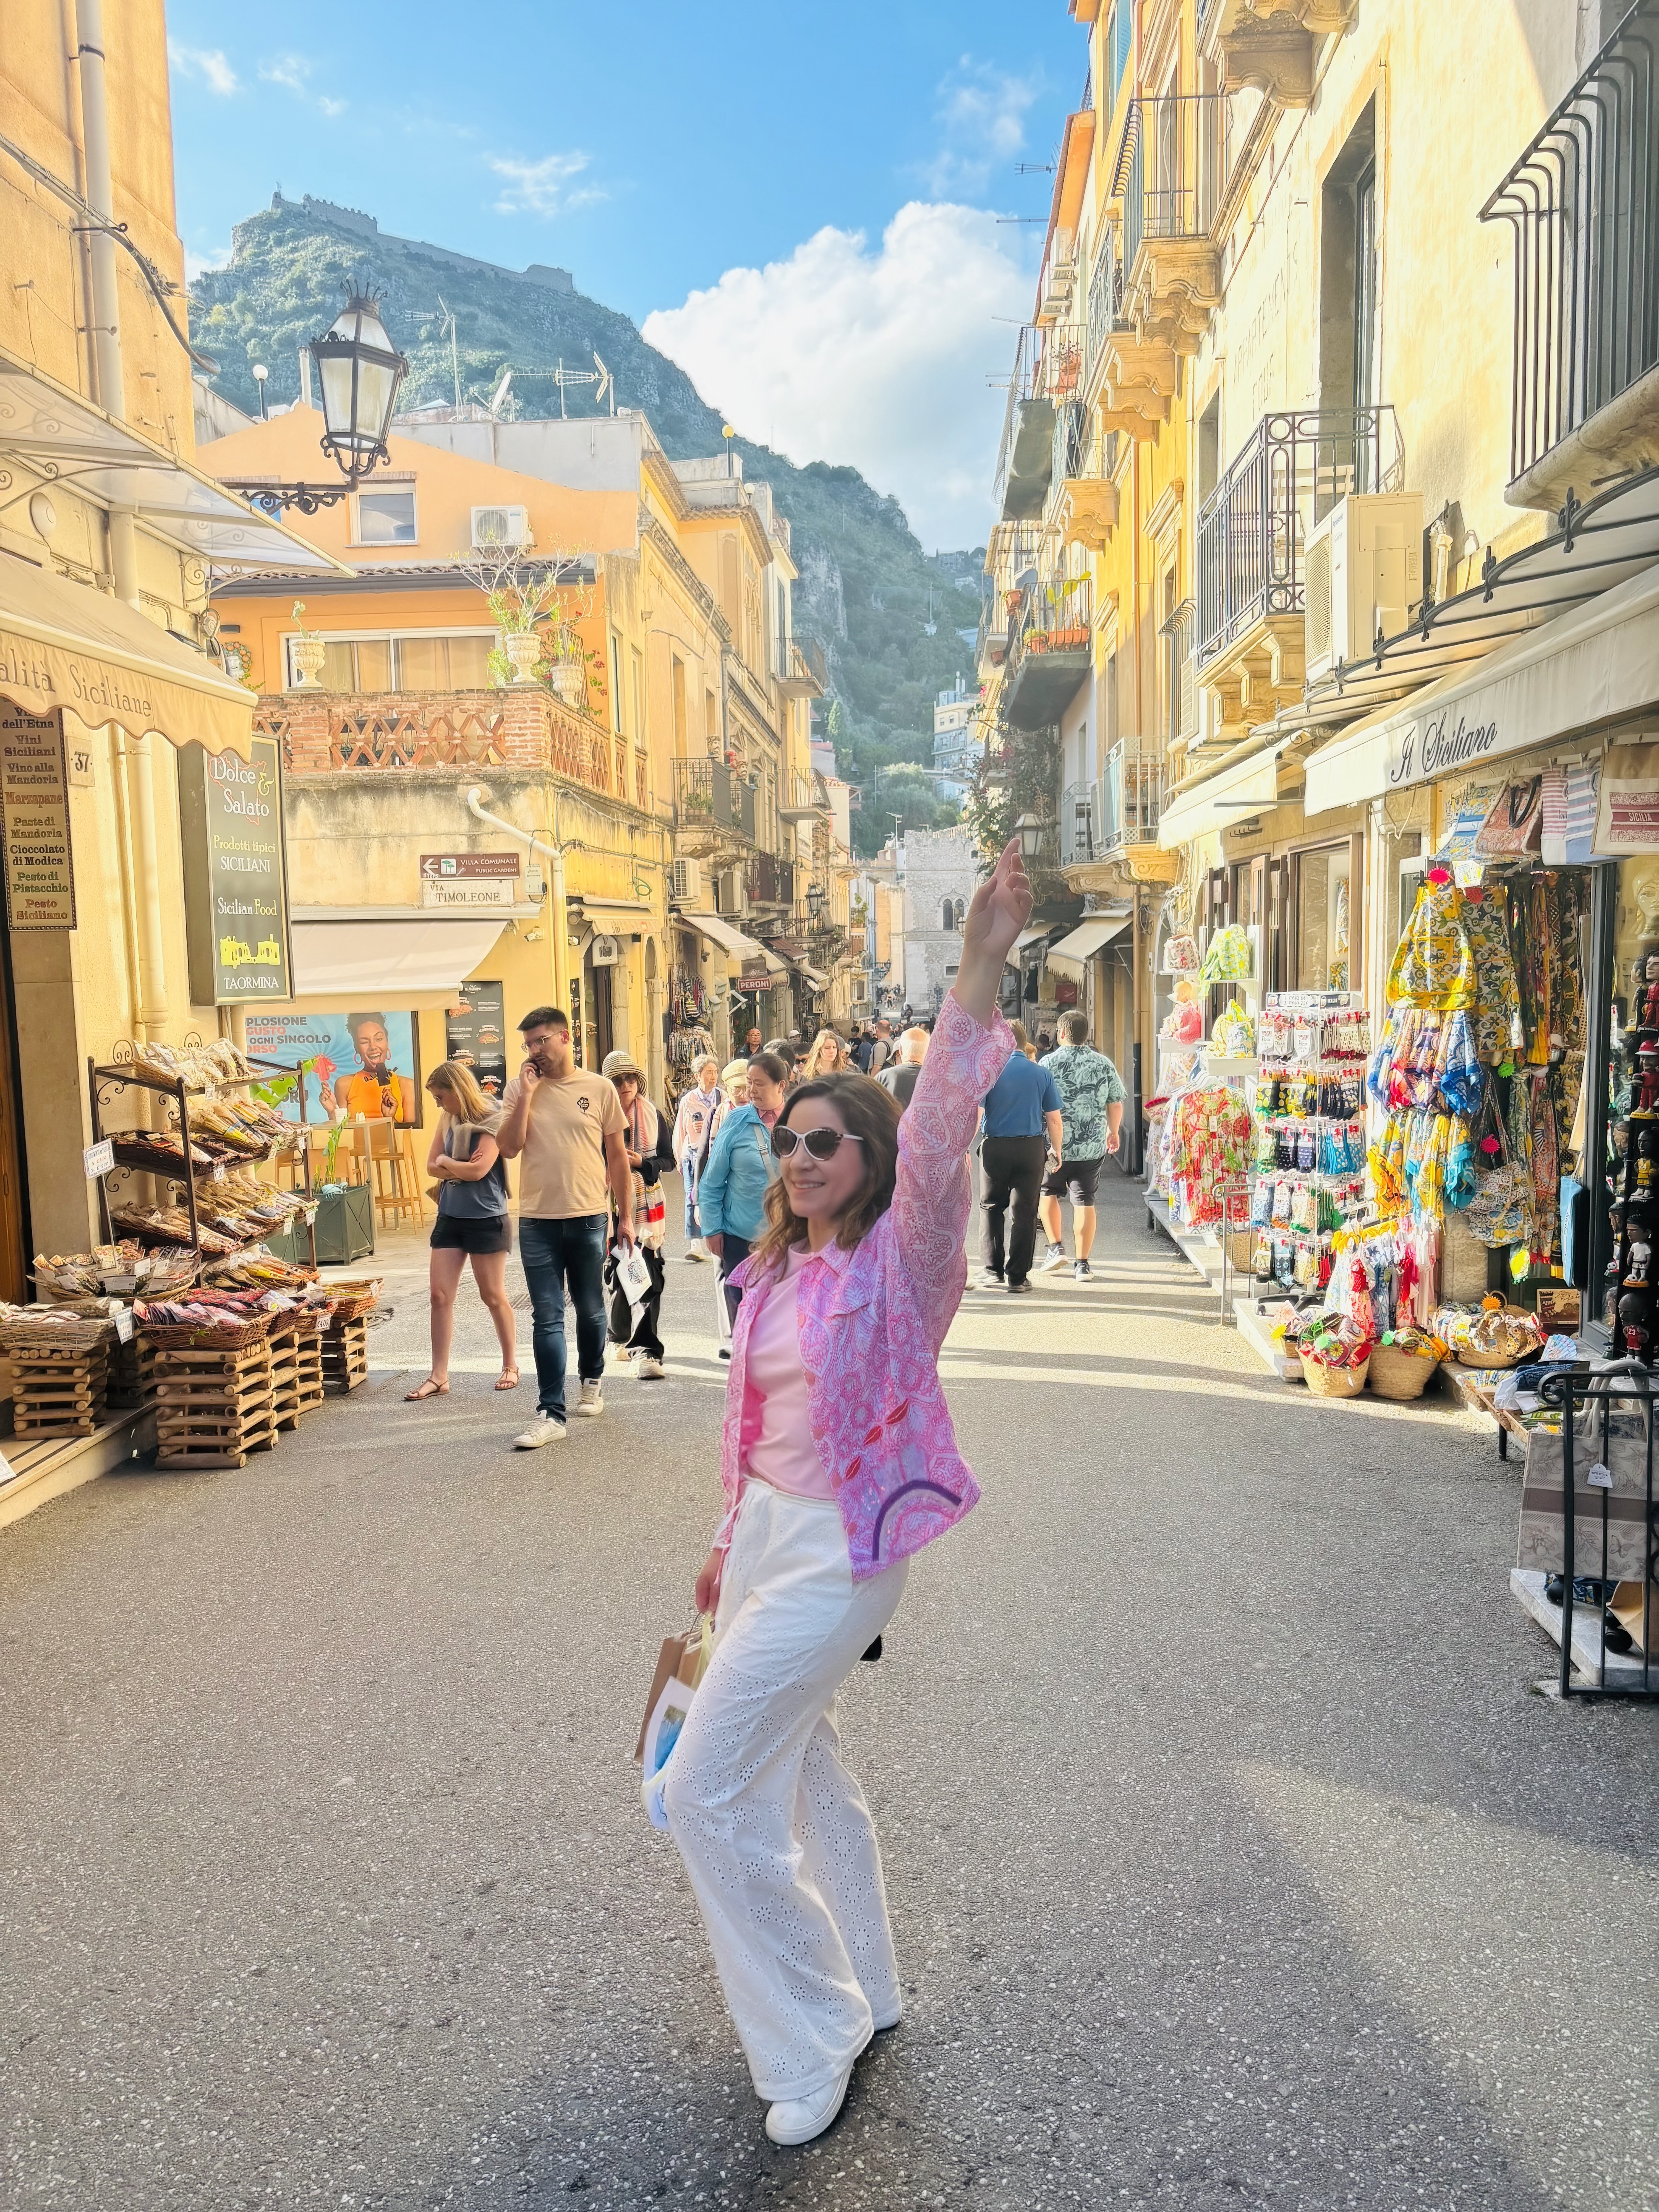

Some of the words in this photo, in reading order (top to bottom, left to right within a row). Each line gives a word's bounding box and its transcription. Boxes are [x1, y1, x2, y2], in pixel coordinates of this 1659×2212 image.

[69, 664, 151, 717] Siciliane
[2, 719, 54, 729] dell'Etna
[15, 735, 42, 744] Vini
[1422, 711, 1498, 775] Siciliano
[4, 747, 57, 756] Siciliani
[7, 763, 33, 772] Vino
[34, 763, 55, 772] alla
[7, 775, 59, 784] Mandorla
[213, 756, 256, 785] Dolce
[258, 772, 275, 796] &
[4, 792, 63, 808] Marzapane
[223, 788, 269, 817] Salato
[13, 817, 43, 826] Paste
[45, 816, 55, 826] di
[1628, 812, 1652, 822] SICILIA
[10, 829, 62, 838] Mandorla
[10, 844, 65, 854] Cioccolato
[213, 834, 250, 851] Prodotti
[252, 841, 276, 855] tipici
[12, 856, 23, 866] di
[24, 856, 64, 866] Modica
[221, 856, 271, 873] SICILIANI
[17, 872, 47, 881] Pesto
[48, 871, 59, 881] di
[12, 883, 69, 893] Pistacchio
[435, 892, 501, 902] TIMOLEONE
[25, 899, 58, 908] Pesto
[218, 896, 253, 915] Sicilian
[254, 898, 278, 916] Food
[16, 910, 68, 920] Siciliano
[223, 976, 280, 989] TAORMINA
[740, 980, 769, 989] PERONI
[246, 1026, 286, 1035] GUSTO
[277, 1034, 331, 1044] SINGOLO
